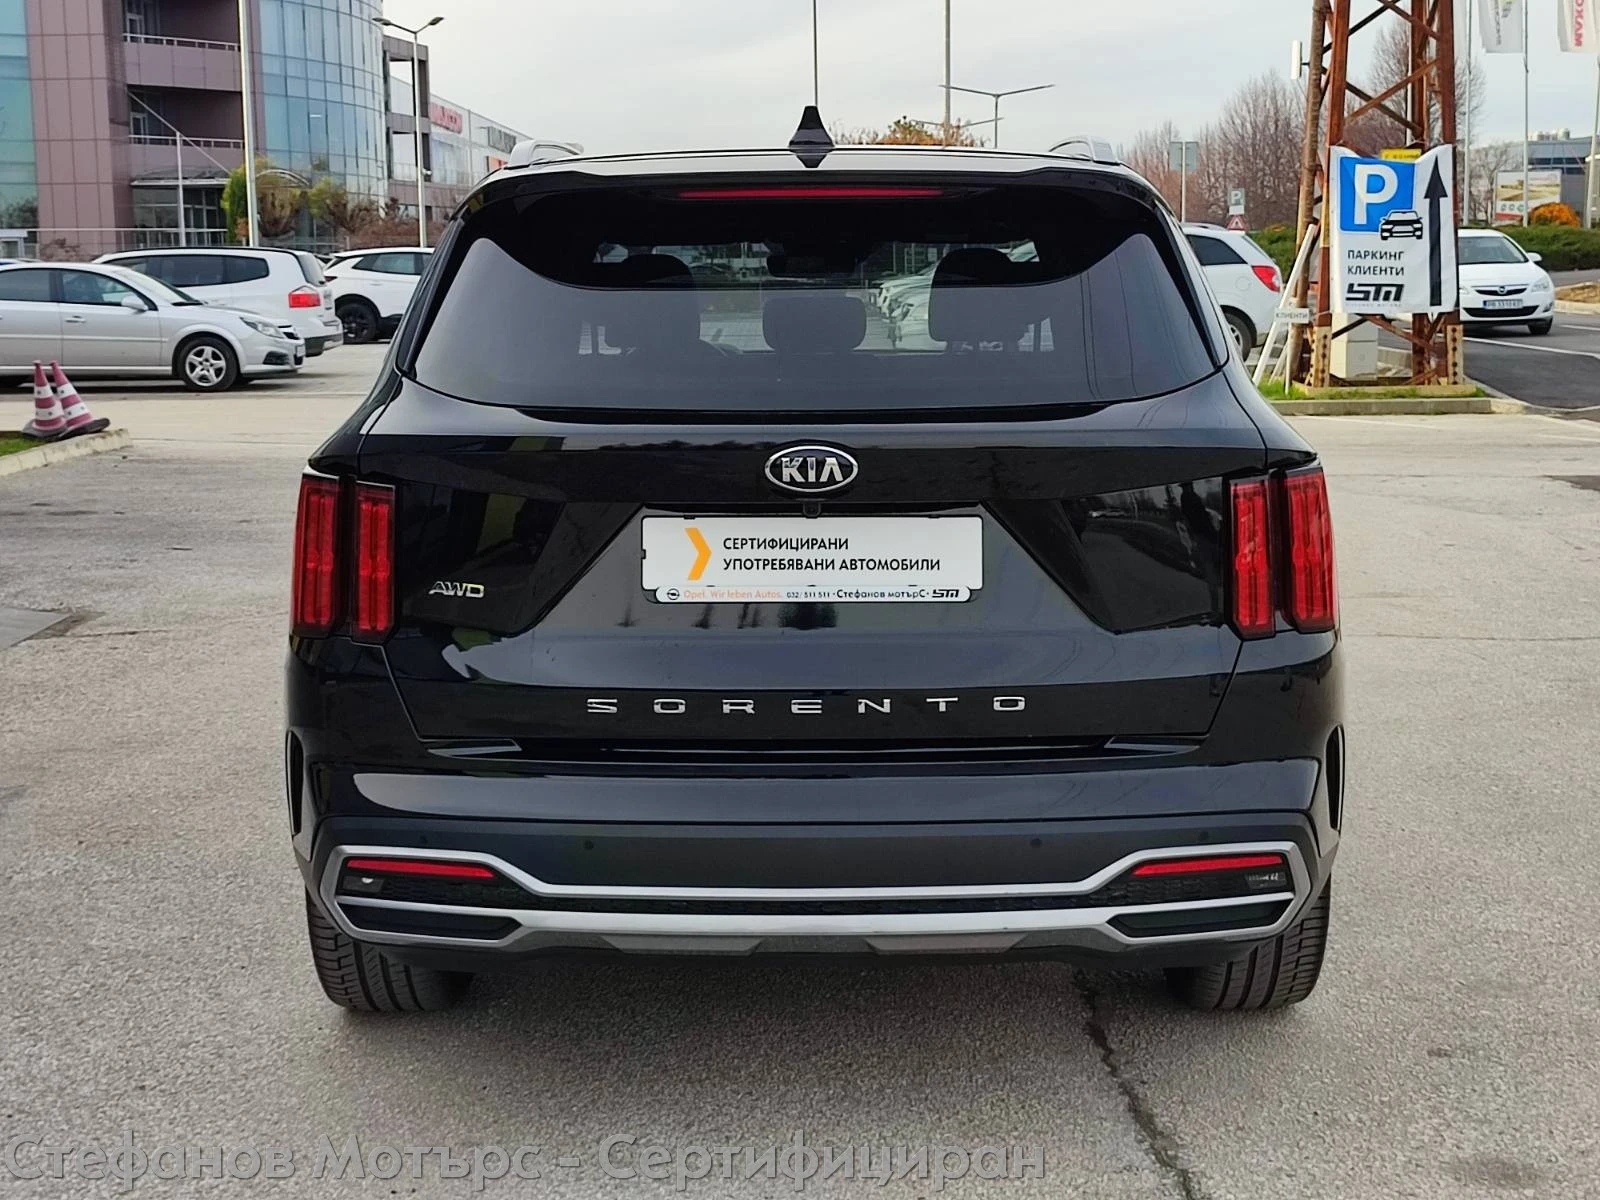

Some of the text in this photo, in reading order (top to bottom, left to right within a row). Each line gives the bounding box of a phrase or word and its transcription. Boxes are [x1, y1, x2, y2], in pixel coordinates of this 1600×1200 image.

[1230, 190, 1242, 204] P
[1354, 164, 1399, 225] P
[1347, 250, 1405, 261] ПАРКИНГ
[1347, 265, 1405, 276] КЛИЕНТИ
[780, 457, 844, 482] KIA
[723, 537, 849, 552] СЕРТИФИЦИРАНИ
[723, 558, 940, 571] УПОТРЕБЯВАНИ АВТОМОБИЛИ
[428, 581, 485, 598] AWD
[727, 589, 753, 599] leben
[586, 696, 1026, 714] SORENTO
